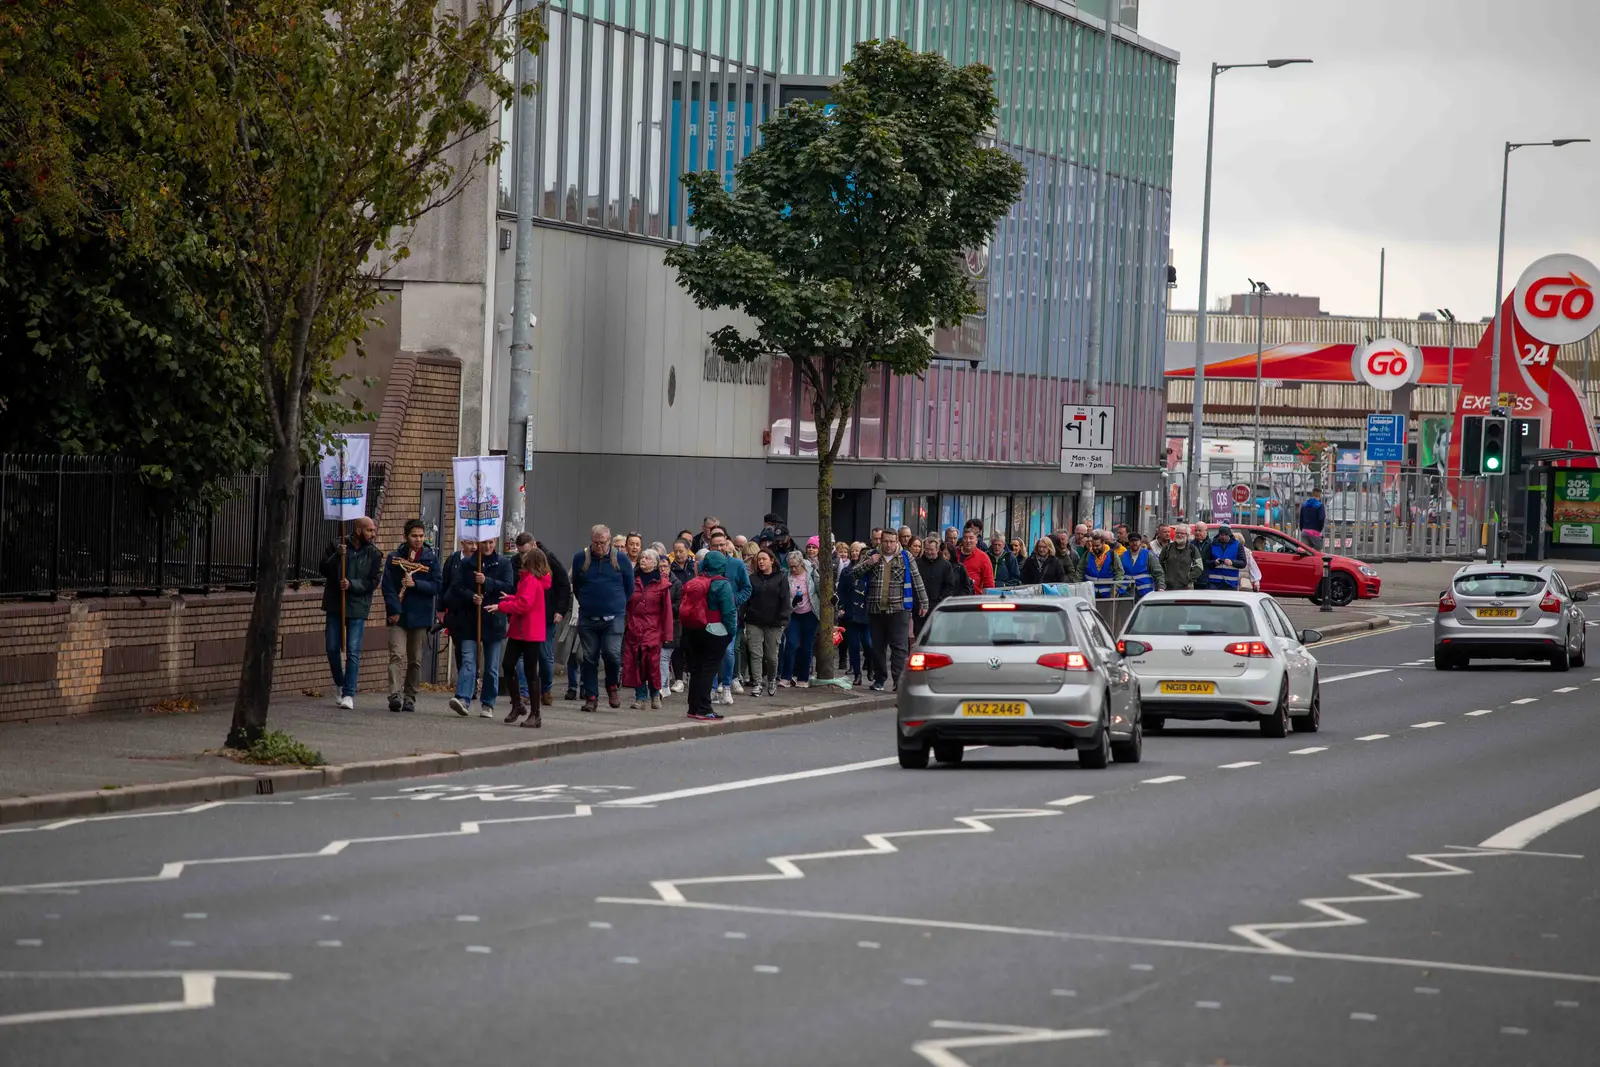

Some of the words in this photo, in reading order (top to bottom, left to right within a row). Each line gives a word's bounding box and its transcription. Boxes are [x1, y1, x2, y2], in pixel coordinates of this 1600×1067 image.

[1520, 344, 1549, 366] 24
[1462, 395, 1534, 411] EXPSS
[1567, 480, 1590, 488] 30%
[1566, 487, 1590, 497] OFF
[1479, 609, 1494, 617] PFZ
[1495, 609, 1513, 617] 3687
[1166, 683, 1187, 692] NG13
[967, 703, 989, 714] KXZ
[992, 703, 1021, 714] 2445
